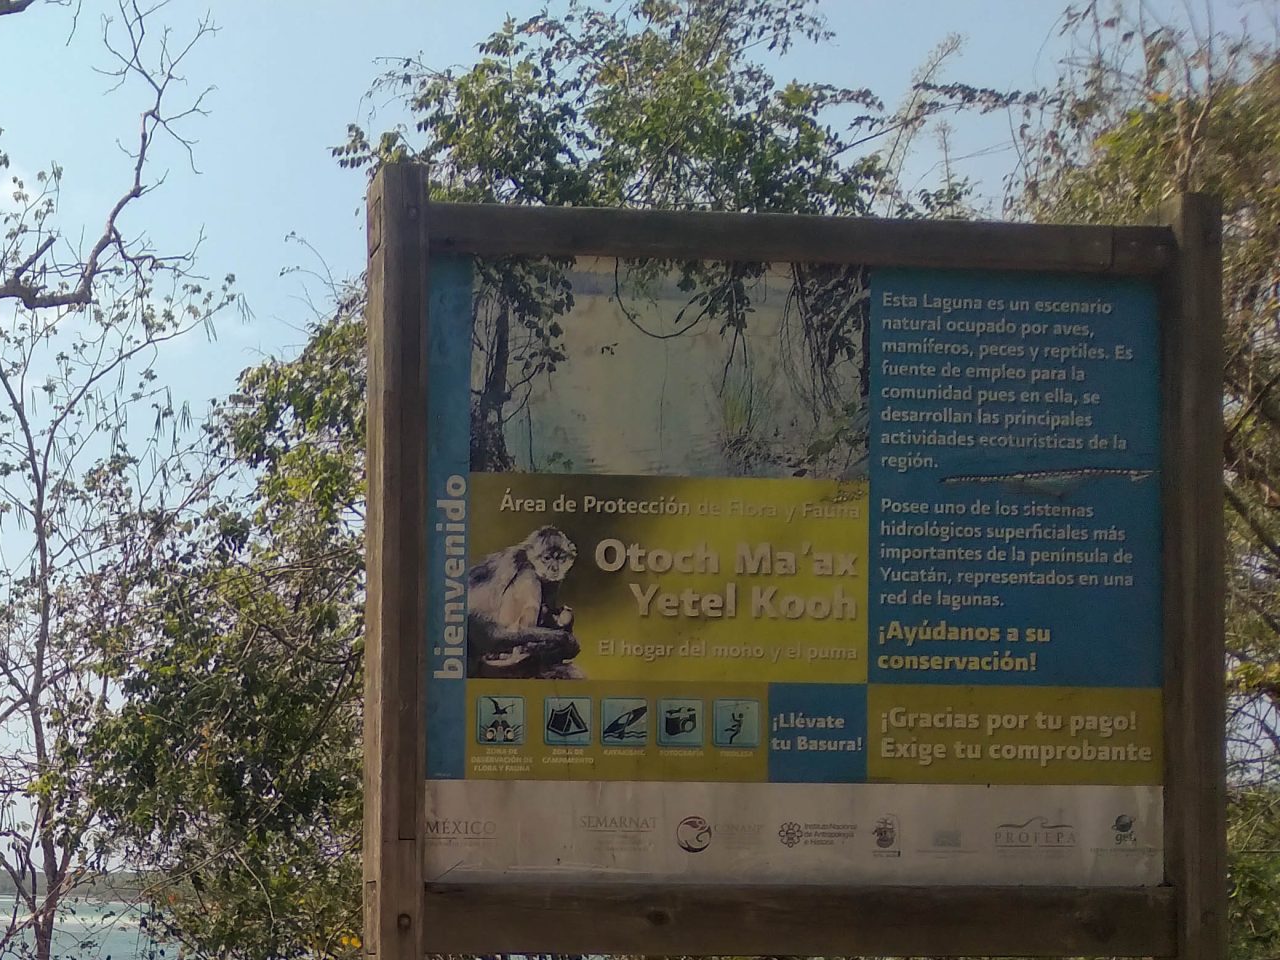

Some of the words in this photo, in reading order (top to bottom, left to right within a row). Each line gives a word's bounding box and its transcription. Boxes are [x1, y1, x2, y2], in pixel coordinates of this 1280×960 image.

[882, 292, 917, 307] Esta
[923, 294, 982, 313] Laguna
[987, 299, 1005, 310] es
[1009, 299, 1030, 311] un
[1035, 300, 1112, 314] escenario
[882, 316, 941, 331] natural
[946, 318, 1016, 337] ocupado
[1021, 323, 1048, 338] por
[1053, 325, 1095, 338] aves,
[882, 338, 974, 357] mamíferos,
[979, 344, 1024, 359] peces
[1030, 347, 1039, 361] y
[1044, 344, 1109, 362] reptiles.
[1115, 345, 1133, 360] Es
[881, 360, 936, 377] fuente
[941, 362, 961, 377] de
[966, 363, 1026, 383] empleo
[1031, 369, 1067, 384] para
[1072, 366, 1085, 381] la
[881, 385, 972, 400] comunidad
[977, 390, 1016, 404] pues
[1021, 391, 1039, 403] en
[1045, 389, 1078, 405] ella,
[1083, 393, 1100, 404] se
[881, 407, 972, 423] desarrollan
[977, 409, 1000, 424] las
[1005, 410, 1093, 430] principales
[880, 430, 975, 446] actividades
[1089, 435, 1108, 449] de
[1113, 435, 1127, 450] la
[880, 453, 939, 472] región.
[499, 488, 546, 514] Área
[552, 494, 577, 513] de
[583, 495, 690, 517] Protección
[698, 500, 720, 516] de
[729, 500, 776, 517] Flora
[784, 504, 795, 523] y
[802, 502, 861, 520] Fauna
[880, 498, 929, 513] Posee
[934, 502, 966, 514] uno
[970, 500, 991, 515] de
[996, 501, 1019, 516] los
[1023, 502, 1094, 517] sistemas
[880, 521, 982, 542] hidrológicos
[986, 524, 1089, 543] superficiales
[1093, 525, 1126, 540] más
[595, 538, 719, 575] Otoch
[880, 544, 982, 563] importantes
[987, 547, 1007, 561] de
[1012, 547, 1026, 562] la
[1030, 548, 1108, 565] península
[1113, 549, 1133, 563] de
[433, 473, 467, 680] bienvenido
[880, 567, 952, 584] Yucatán,
[957, 570, 1075, 587] representados
[1079, 574, 1098, 585] en
[1104, 574, 1134, 586] una
[629, 582, 737, 618] Yetel
[752, 585, 858, 620] Kooh
[880, 590, 907, 605] red
[912, 591, 932, 605] de
[937, 591, 1005, 610] lagunas.
[879, 620, 1000, 646] ¡Ayúdanos
[1007, 628, 1019, 641] a
[1025, 629, 1051, 642] su
[598, 640, 616, 656] El
[620, 641, 674, 661] hogar
[679, 640, 707, 658] del
[713, 644, 764, 659] mono
[771, 645, 781, 663] y
[786, 643, 802, 659] el
[809, 645, 858, 663] puma
[877, 652, 1037, 671] conservación!
[772, 712, 846, 730] ¡Llévate
[880, 707, 980, 732] ¡Gracias
[987, 711, 1028, 736] por
[1035, 711, 1063, 730] tu
[1070, 711, 1137, 738] pago!
[771, 738, 792, 750] tu
[797, 736, 863, 753] Basura!
[880, 738, 947, 766] Exige
[953, 740, 982, 759] tu
[988, 739, 1153, 767] comprobante
[425, 818, 497, 835] MÉXICO
[580, 815, 657, 829] SEMARNAT
